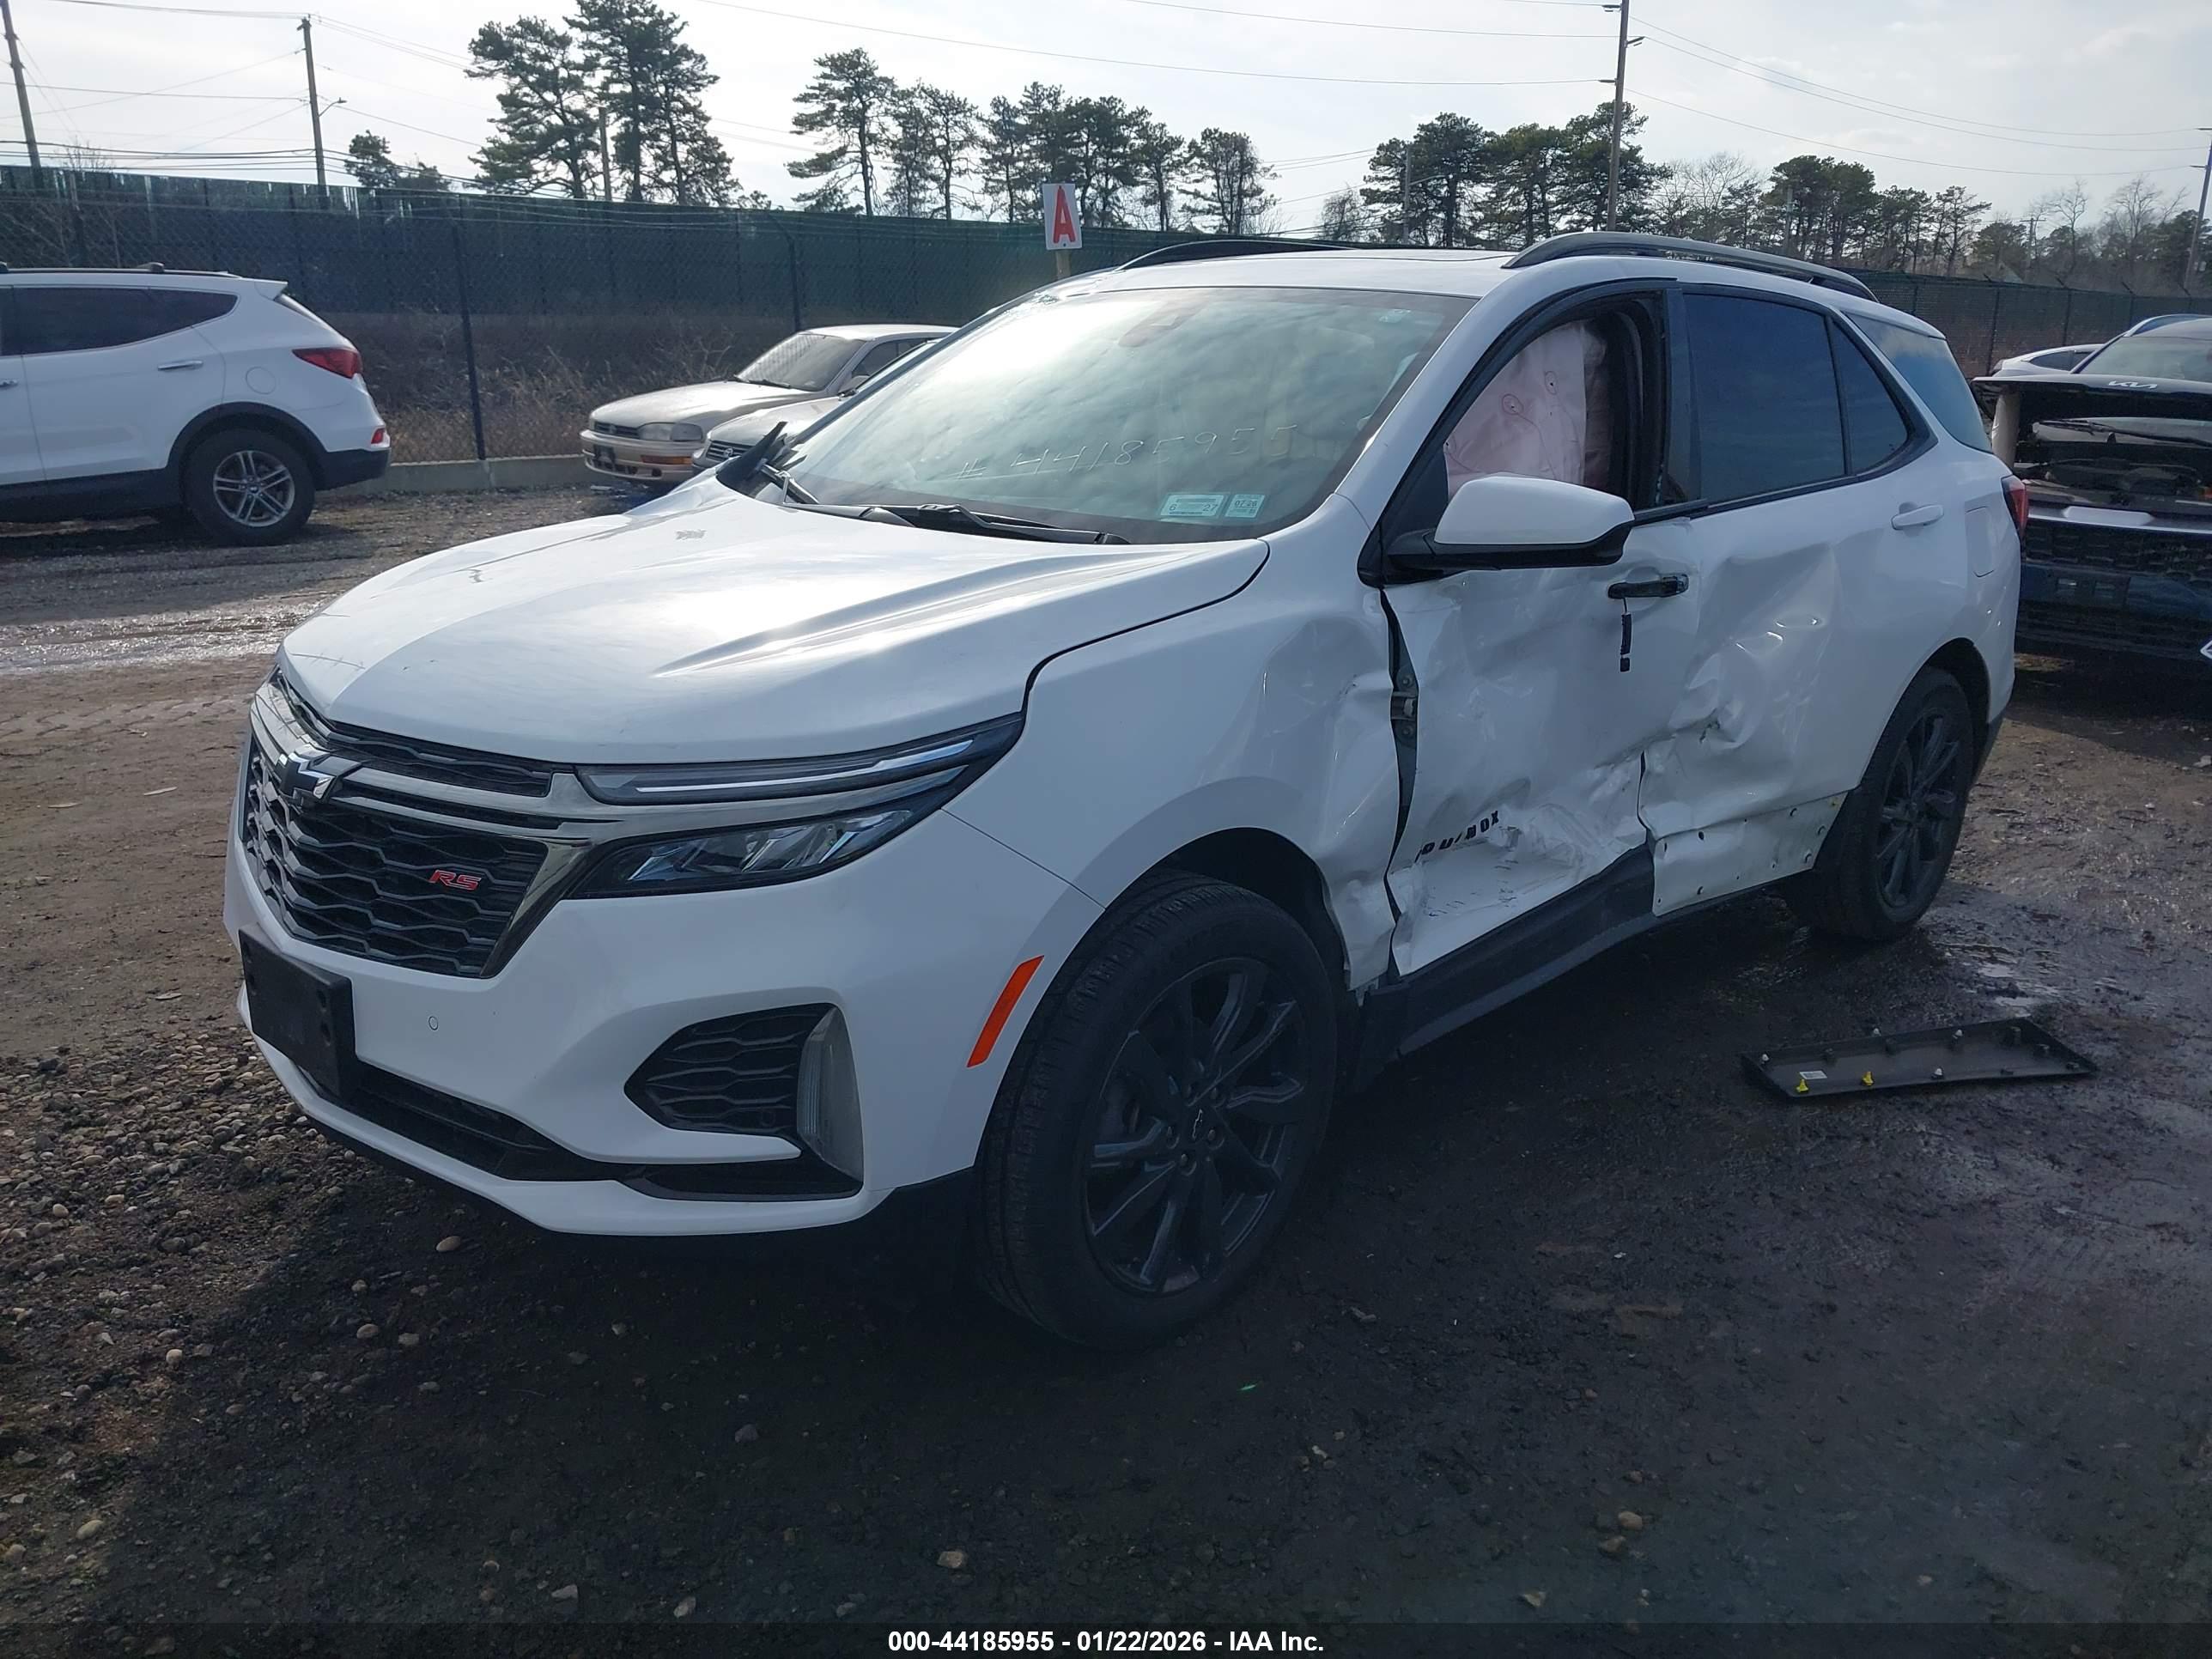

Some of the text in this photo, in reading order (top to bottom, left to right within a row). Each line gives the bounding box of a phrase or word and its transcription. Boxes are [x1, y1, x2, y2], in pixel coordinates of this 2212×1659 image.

[1053, 185, 1076, 244] A
[1011, 424, 1298, 475] 44185955
[1202, 503, 1218, 512] 27
[428, 869, 483, 891] RS
